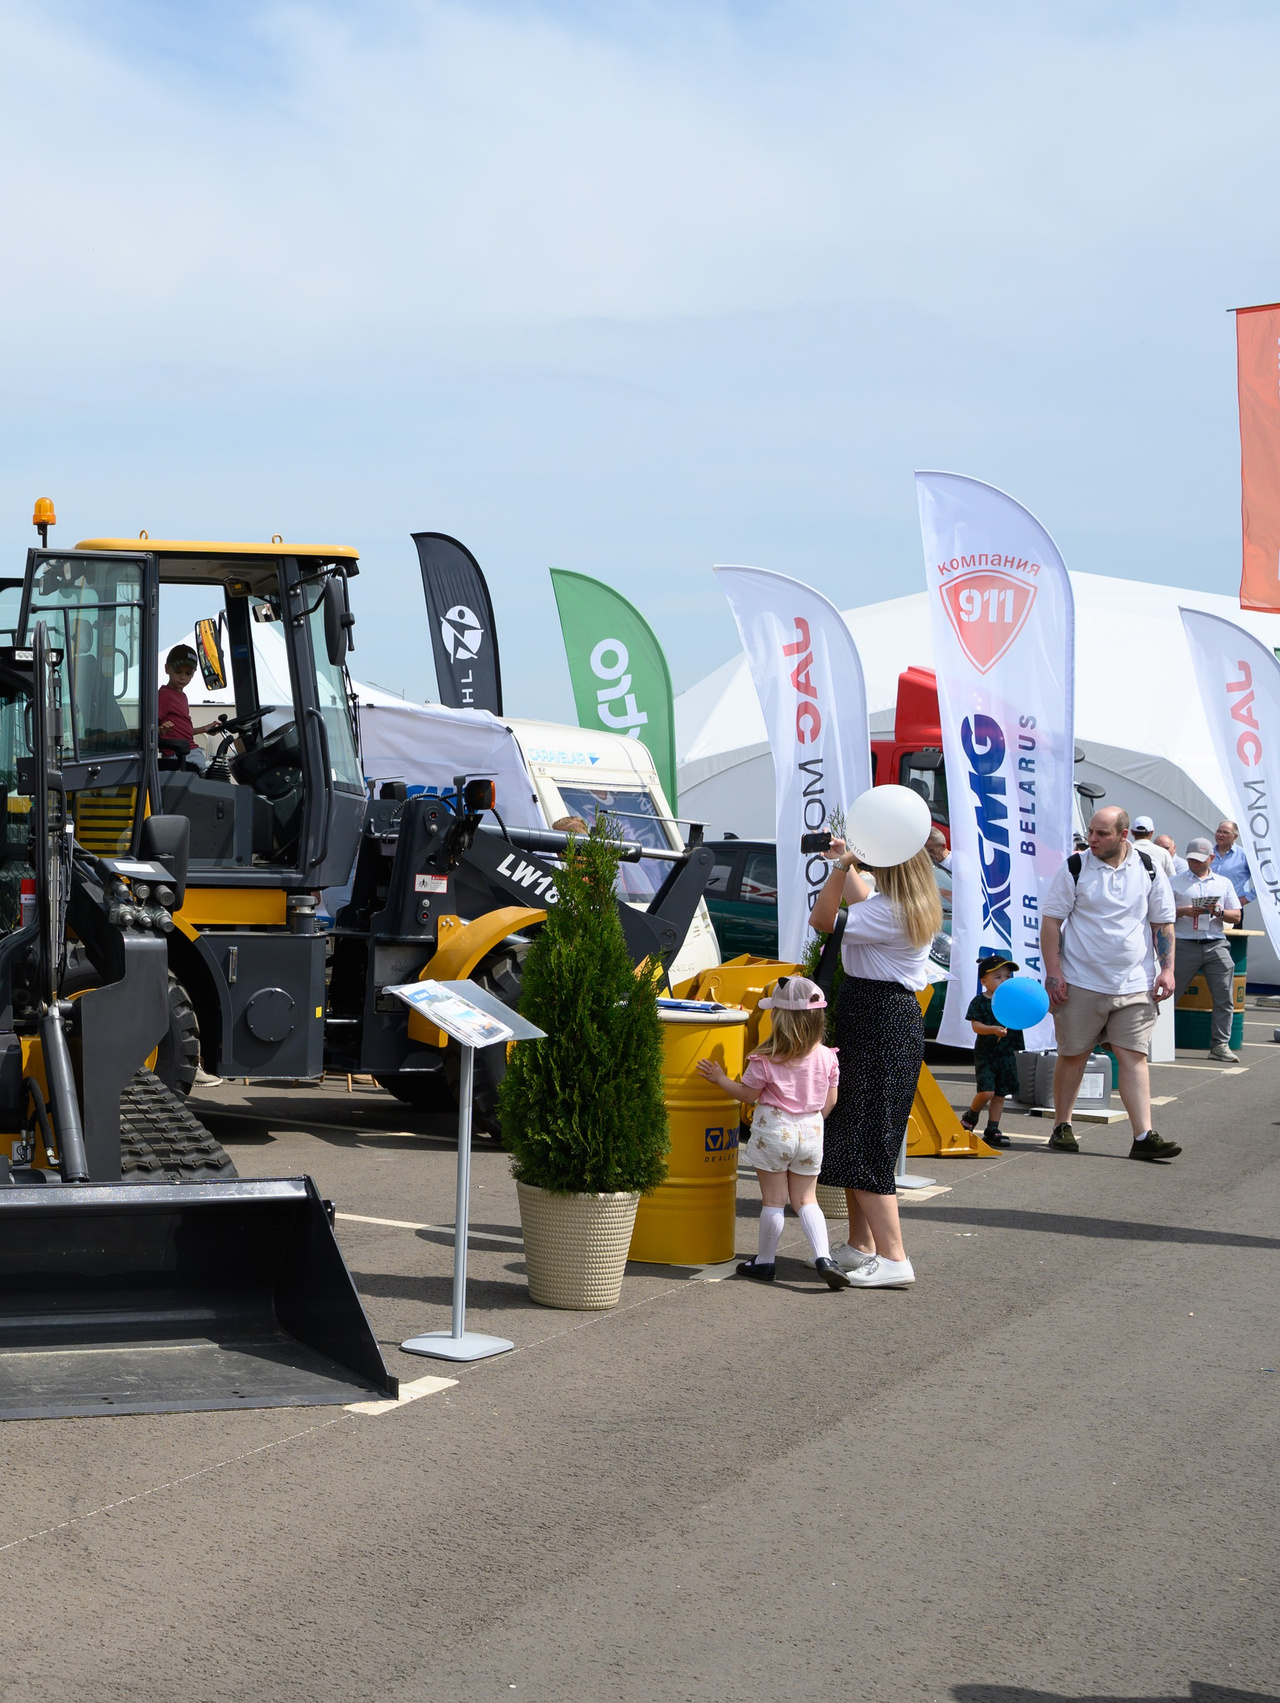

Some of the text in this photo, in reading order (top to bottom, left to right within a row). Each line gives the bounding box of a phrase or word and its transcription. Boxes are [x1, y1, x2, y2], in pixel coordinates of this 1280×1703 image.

[937, 553, 1041, 577] компания
[959, 588, 1014, 623] 911
[461, 670, 474, 709] HL
[528, 748, 587, 765] CARAVELAIR
[961, 714, 1012, 948] XCMG
[1018, 715, 1041, 984] ALER BELARUS
